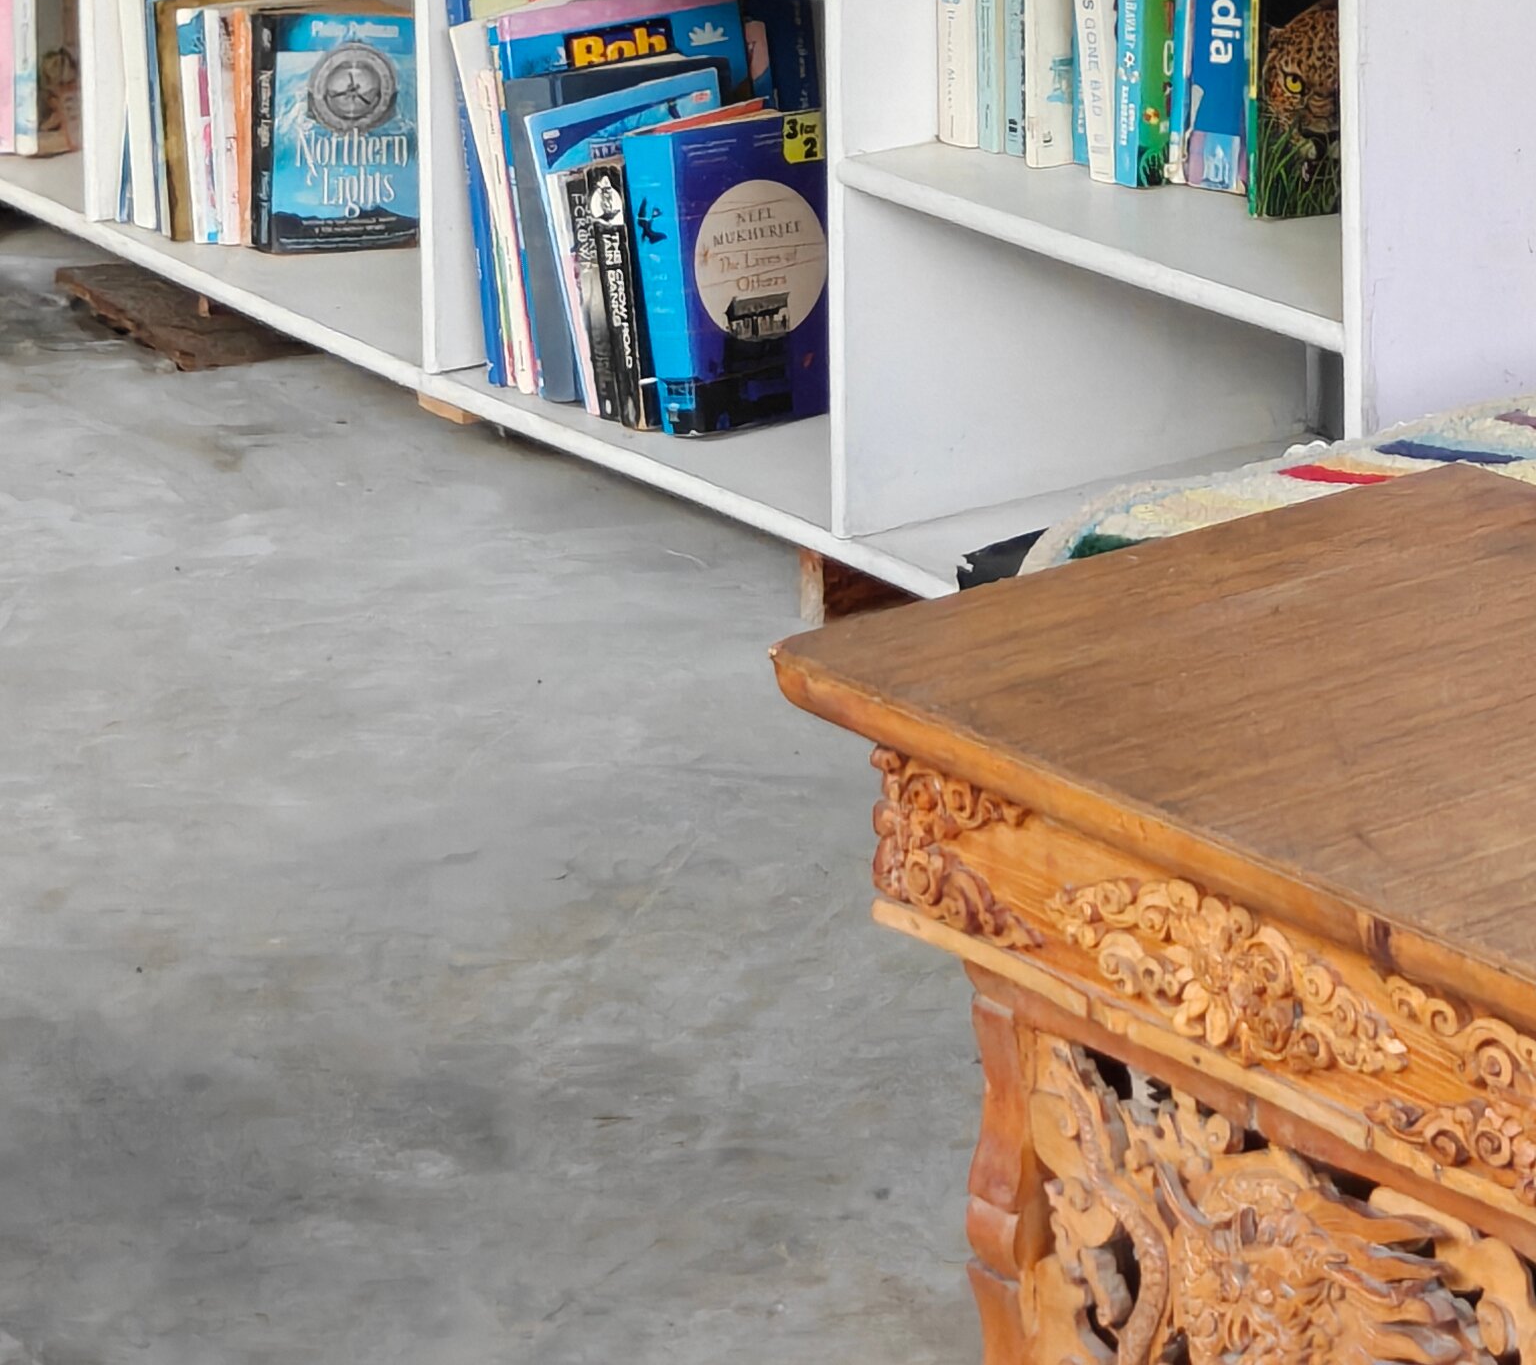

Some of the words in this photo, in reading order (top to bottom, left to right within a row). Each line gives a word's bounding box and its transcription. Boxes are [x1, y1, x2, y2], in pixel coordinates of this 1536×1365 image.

[571, 26, 668, 68] Bob
[1084, 17, 1100, 72] GONE
[1089, 80, 1104, 118] BAD
[295, 127, 409, 174] Northern
[785, 119, 799, 140] 3
[803, 137, 818, 159] 2
[322, 166, 396, 219] Lights
[602, 234, 614, 266] IAIN
[608, 232, 623, 264] THE
[607, 270, 622, 327] BANKS
[613, 268, 628, 320] CROW
[621, 322, 634, 369] ROAD
